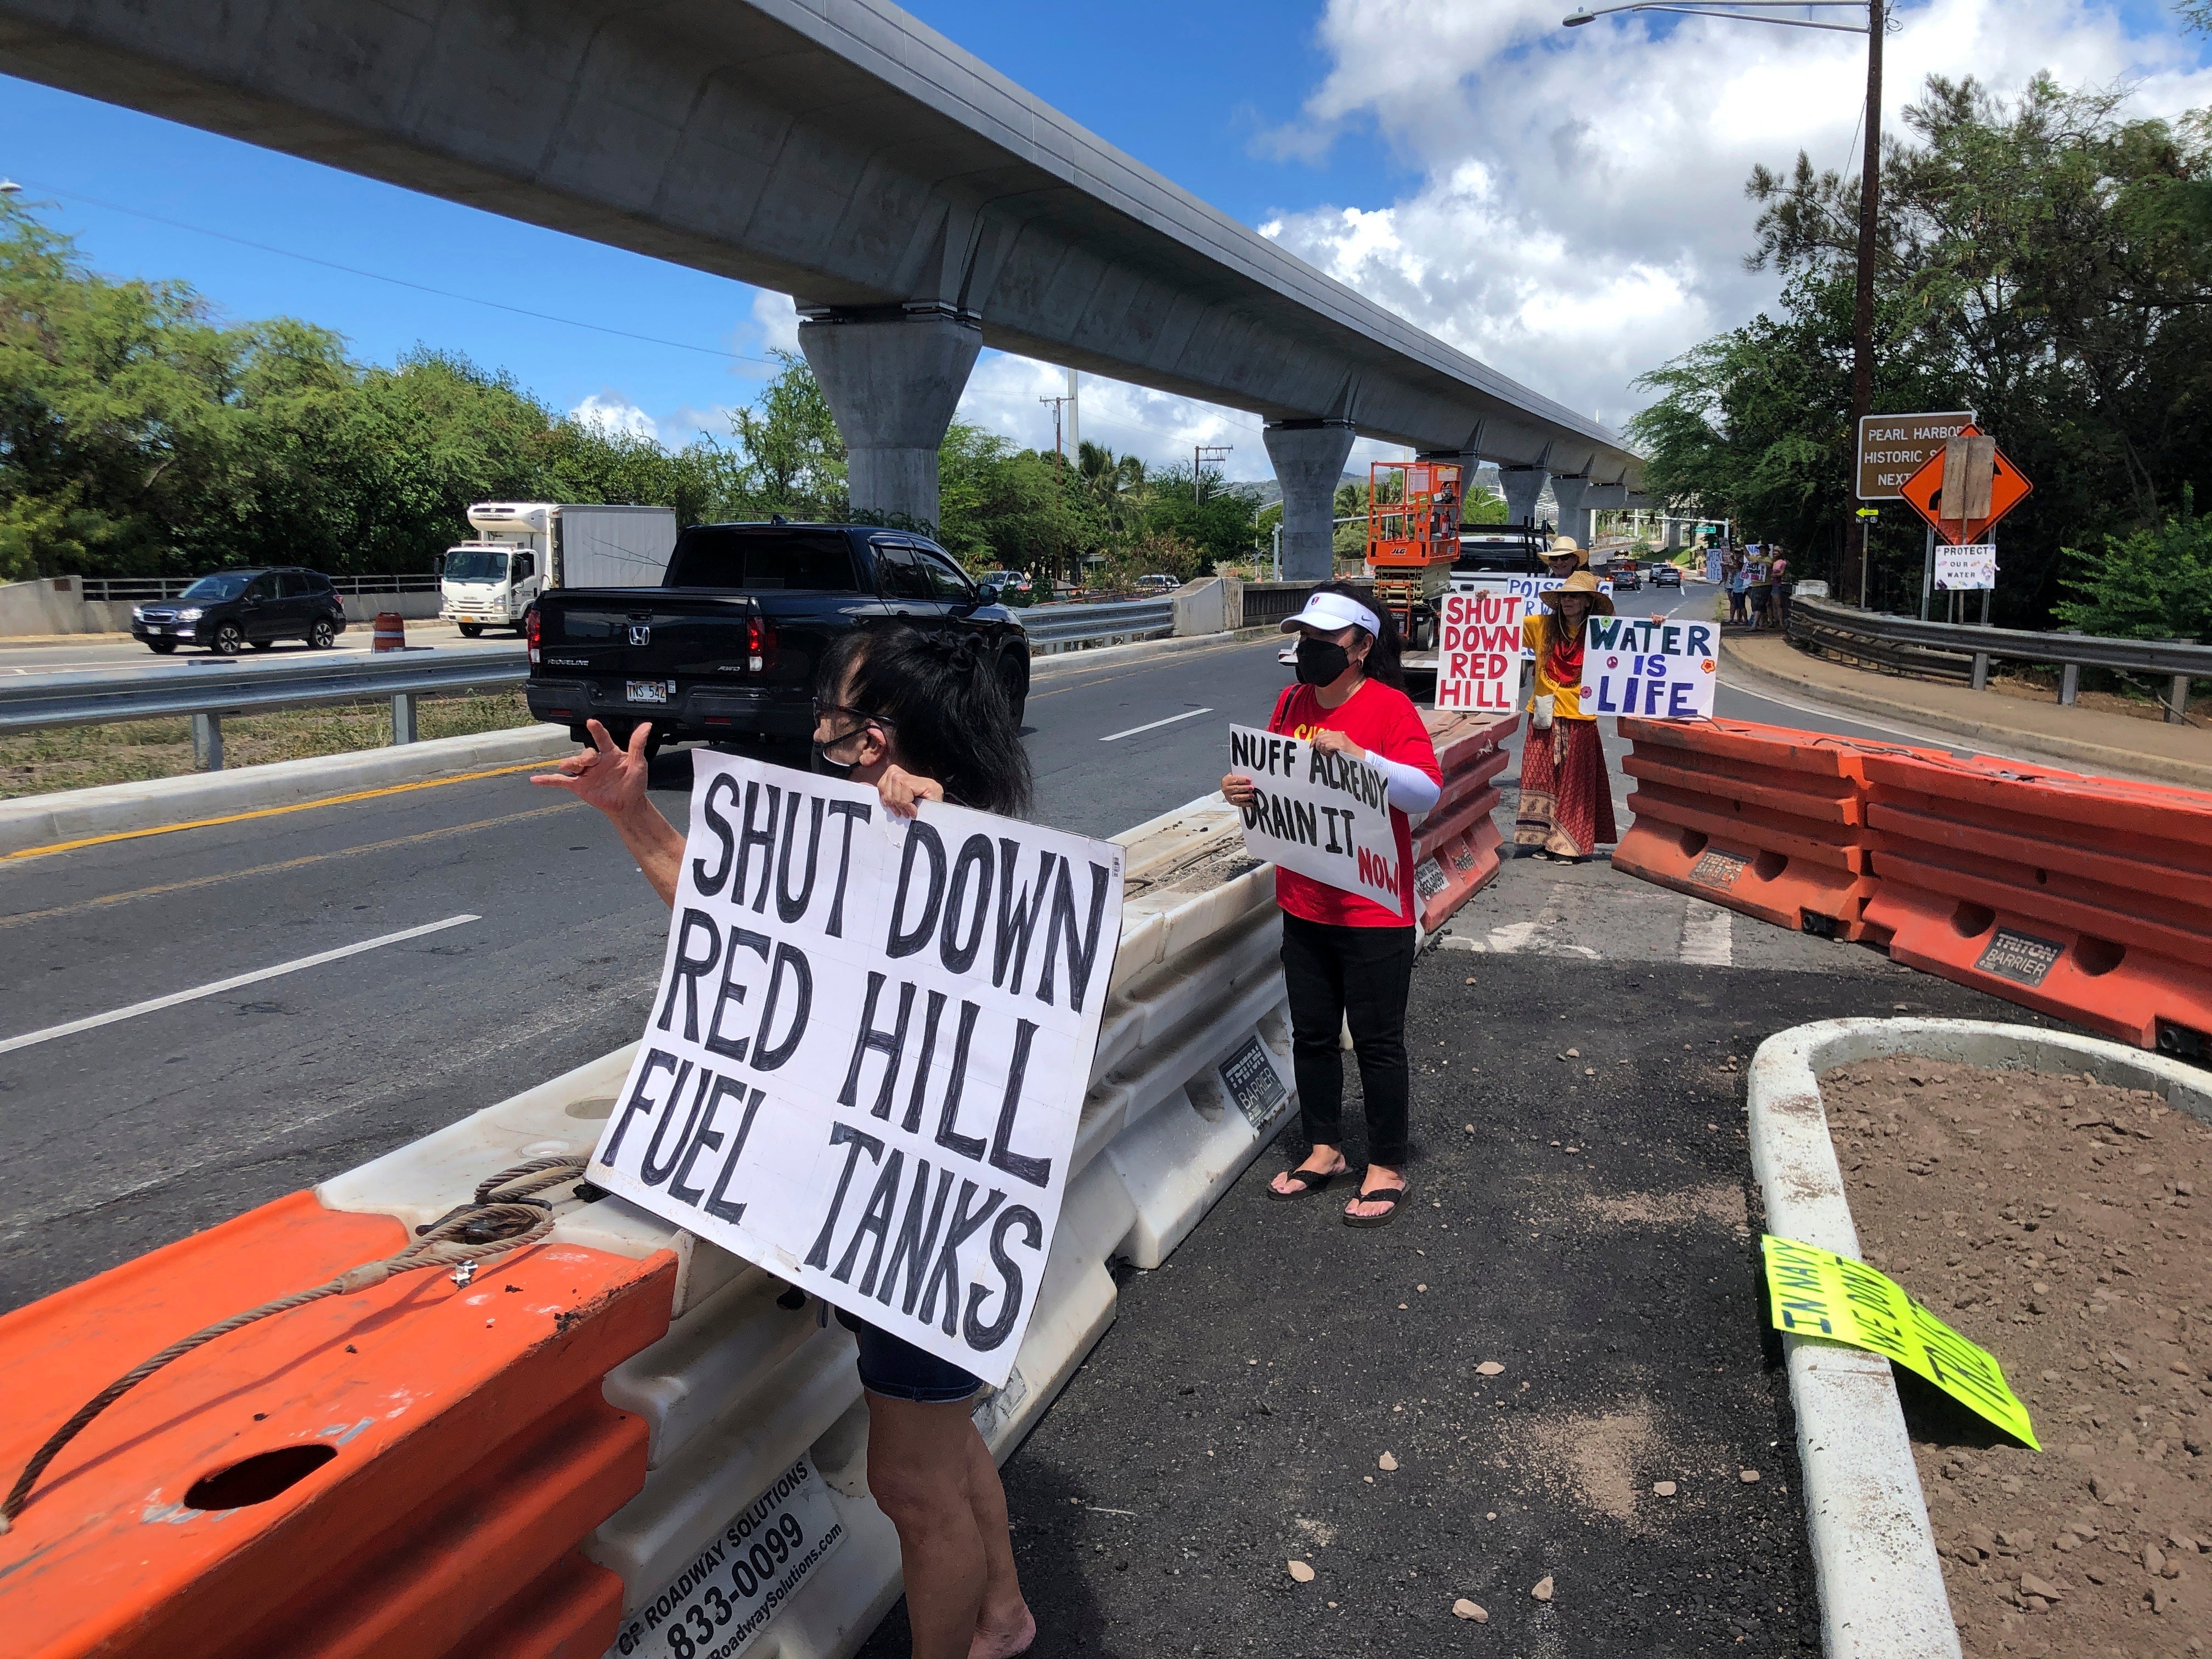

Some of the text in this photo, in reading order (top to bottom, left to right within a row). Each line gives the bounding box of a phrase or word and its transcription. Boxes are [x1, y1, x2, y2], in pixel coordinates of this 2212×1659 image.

[1869, 428, 1908, 442] PEARL
[1864, 450, 1923, 464] HISTORIC
[1878, 473, 1912, 486] NEXT
[1944, 546, 1989, 556] PROTECT
[1707, 568, 1721, 580] LIFE
[1446, 596, 1522, 625] SHUT
[1444, 625, 1520, 652] DOWN
[1589, 618, 1711, 657] WATER
[1449, 653, 1508, 680] RED
[1633, 654, 1666, 678] IS
[627, 684, 665, 698] TNS 542
[1439, 679, 1510, 708] HILL
[1597, 675, 1699, 717] LIFE
[1231, 731, 1297, 778] NUFF
[1309, 744, 1389, 817] ALREADY
[1242, 787, 1355, 858] DRAIN IT
[1357, 846, 1400, 899] NOW
[692, 771, 1110, 1014] SHUT DOWN
[1985, 948, 2046, 978] BARRIER
[1996, 933, 2058, 962] TRITON
[657, 907, 1052, 1188] RED HILL
[1238, 1067, 1276, 1110] BARRIER
[600, 1047, 1042, 1352] FUEL TANKS
[1772, 1239, 1832, 1335] IN NAVY
[1852, 1309, 1909, 1357] WE
[645, 1541, 727, 1631] ROADWAY
[726, 1460, 809, 1548] SOLUTIONS
[667, 1513, 804, 1659] 833-0099
